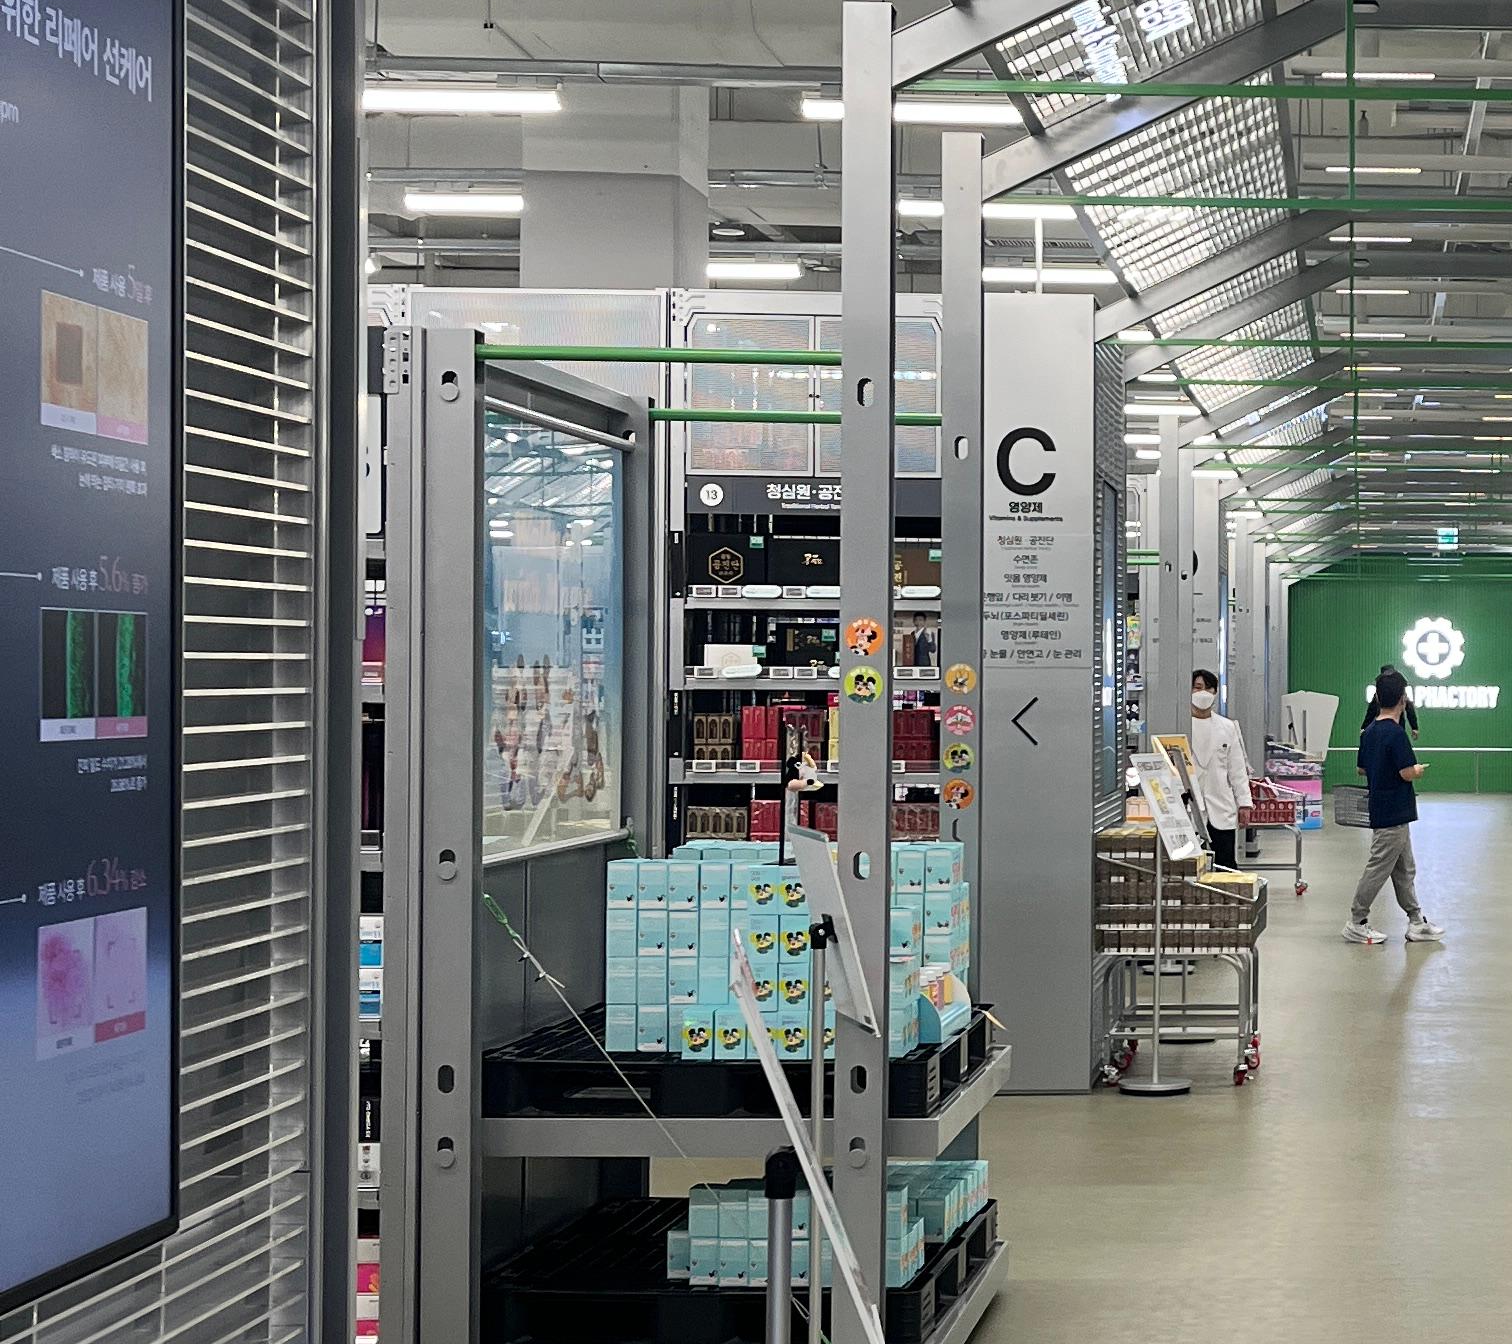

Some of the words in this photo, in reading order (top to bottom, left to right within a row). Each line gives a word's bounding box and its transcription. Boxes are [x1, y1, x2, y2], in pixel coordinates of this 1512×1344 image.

[46, 7, 98, 76] 리페어
[103, 38, 152, 102] 선케어
[996, 427, 1057, 496] C
[1009, 502, 1043, 513] 영양제
[997, 536, 1022, 545] 청심원
[1029, 536, 1054, 545] 공진단
[1414, 686, 1500, 708] PHACTORY
